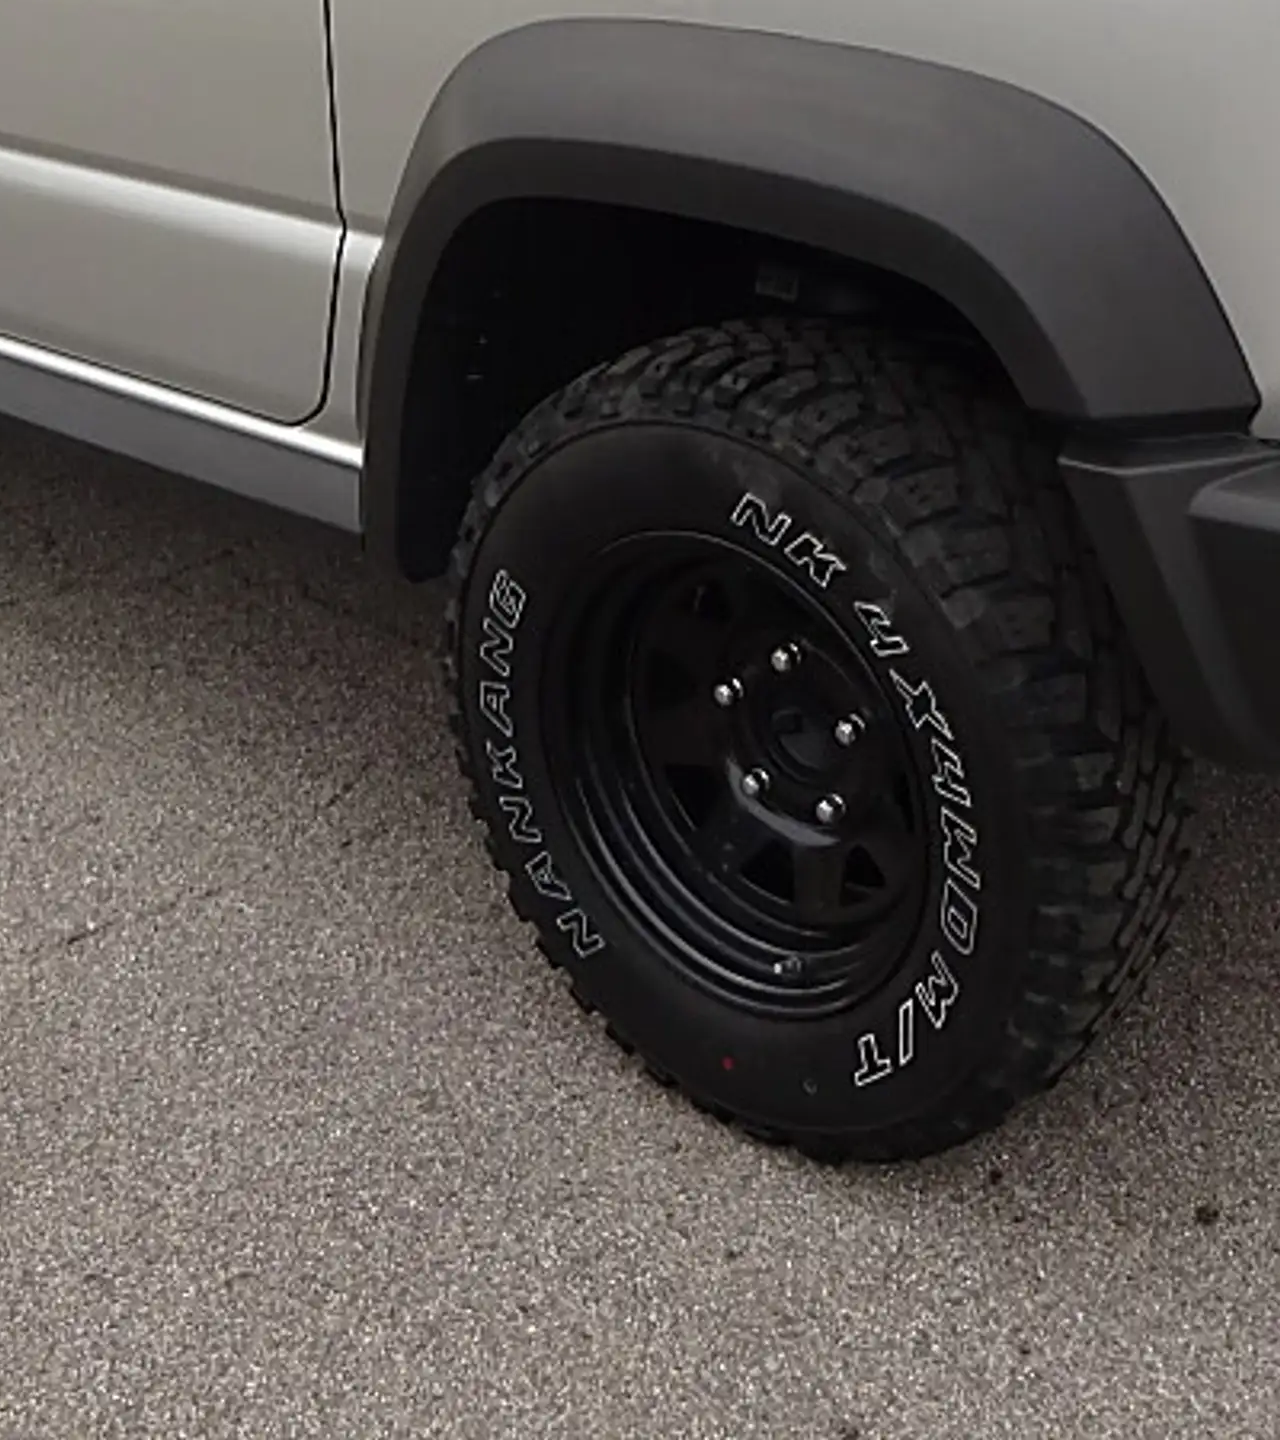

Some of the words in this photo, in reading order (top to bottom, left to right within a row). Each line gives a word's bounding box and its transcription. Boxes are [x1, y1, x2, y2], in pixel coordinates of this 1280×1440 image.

[475, 568, 606, 959] NANKANG
[730, 491, 850, 590] NK
[852, 952, 962, 1090] M/T
